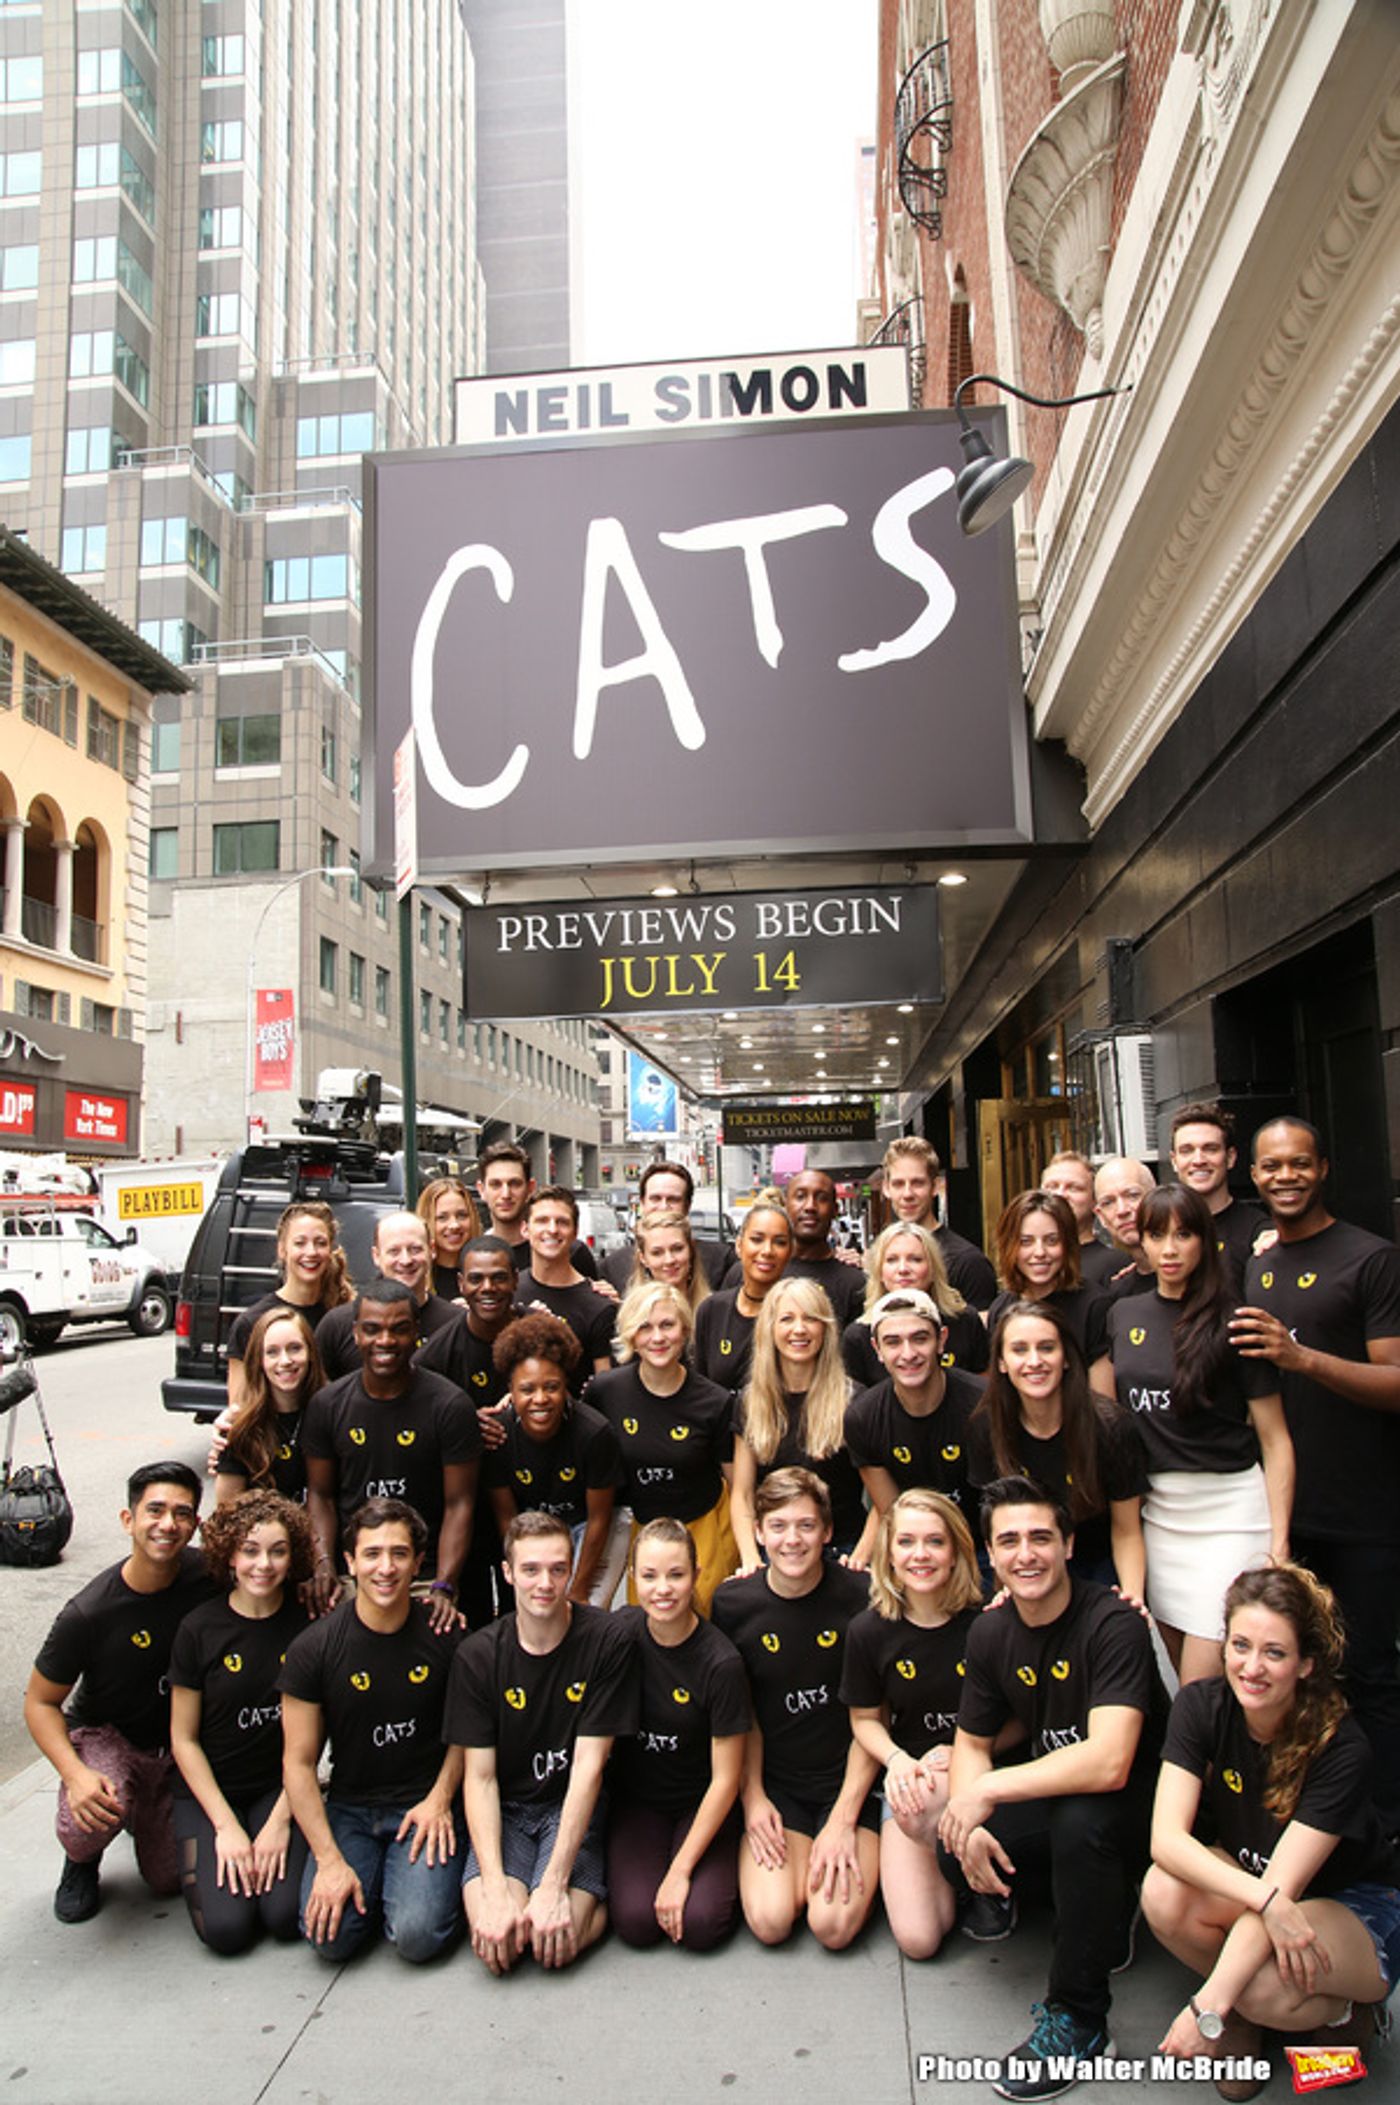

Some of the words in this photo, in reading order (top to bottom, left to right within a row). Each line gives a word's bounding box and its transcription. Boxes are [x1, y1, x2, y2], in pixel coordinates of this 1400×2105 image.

[494, 382, 630, 437] NEIL
[654, 362, 869, 424] SIMON
[411, 466, 957, 810] CATS
[496, 904, 737, 952] PREVIEWS
[755, 896, 902, 939] BEGIN
[599, 952, 727, 1008] JULY
[753, 951, 801, 992] 14
[81, 1098, 95, 1116] The
[726, 1111, 781, 1126] TICKETS
[781, 1111, 801, 1125] ON
[805, 1110, 835, 1124] SALE
[838, 1107, 870, 1121] NOW
[123, 1188, 200, 1214] PLAYBILL
[1129, 1388, 1171, 1413] CATS
[366, 1478, 406, 1498] CATS
[784, 1684, 829, 1714] CATS
[372, 1717, 416, 1747] CATS
[923, 1712, 958, 1731] CAT
[1041, 1725, 1081, 1752] CATS
